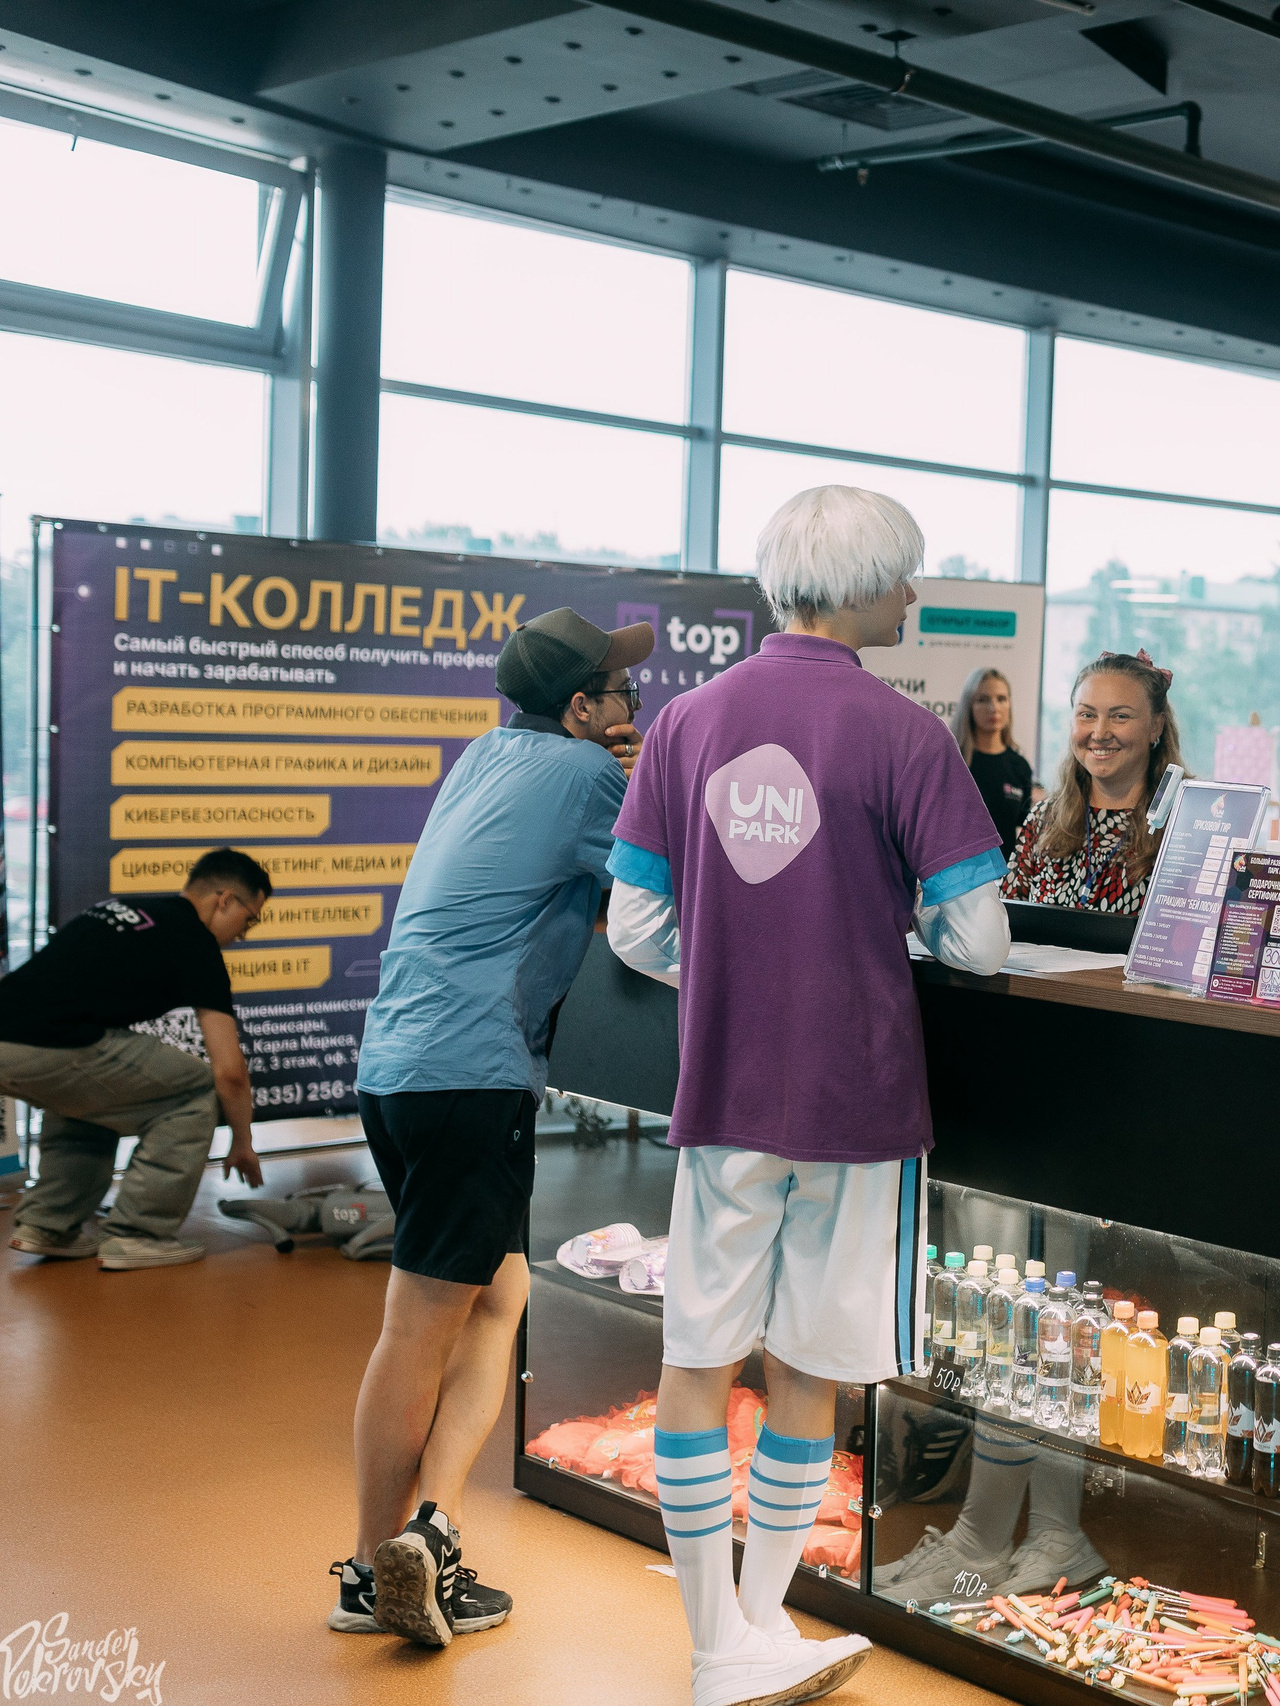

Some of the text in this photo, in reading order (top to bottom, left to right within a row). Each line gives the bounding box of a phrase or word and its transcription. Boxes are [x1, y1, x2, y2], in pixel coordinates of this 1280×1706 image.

[114, 565, 526, 650] IT-КОЛЛЕДЖ
[113, 632, 186, 654] Самый
[188, 635, 278, 660] быстрый
[280, 643, 347, 661] способ
[349, 647, 431, 667] получить
[666, 615, 740, 665] top
[113, 661, 338, 684] и начать зарабатывать
[639, 668, 721, 685] OLLE
[126, 699, 488, 724] РАЗРАБОТКА ПРОГРАММНОГО ОБЕСПЕЧЕНИЯ
[125, 754, 431, 773] КОМПЬЮТЕРНАЯ ГРАФИКА И ДИЗАЙН
[729, 781, 804, 824] UNI
[124, 806, 315, 824] КИБЕРБЕЗОПАСНОСТЬ
[728, 819, 801, 845] PARK
[331, 855, 386, 872] МЕДИА
[390, 855, 400, 868] И
[1267, 867, 1279, 875] ПАРК
[1155, 894, 1187, 908] АТТРАКЦИОН
[278, 904, 371, 924] ИНТЕЛЛЕКТ
[281, 958, 291, 974] В
[296, 957, 311, 973] IT
[253, 1037, 298, 1055] Карла
[300, 1034, 357, 1051] Маркса,
[270, 1055, 281, 1071] 3
[282, 1055, 322, 1070] этаж,
[324, 1051, 347, 1067] оф.
[250, 1082, 304, 1109] (835)
[332, 1207, 360, 1225] top
